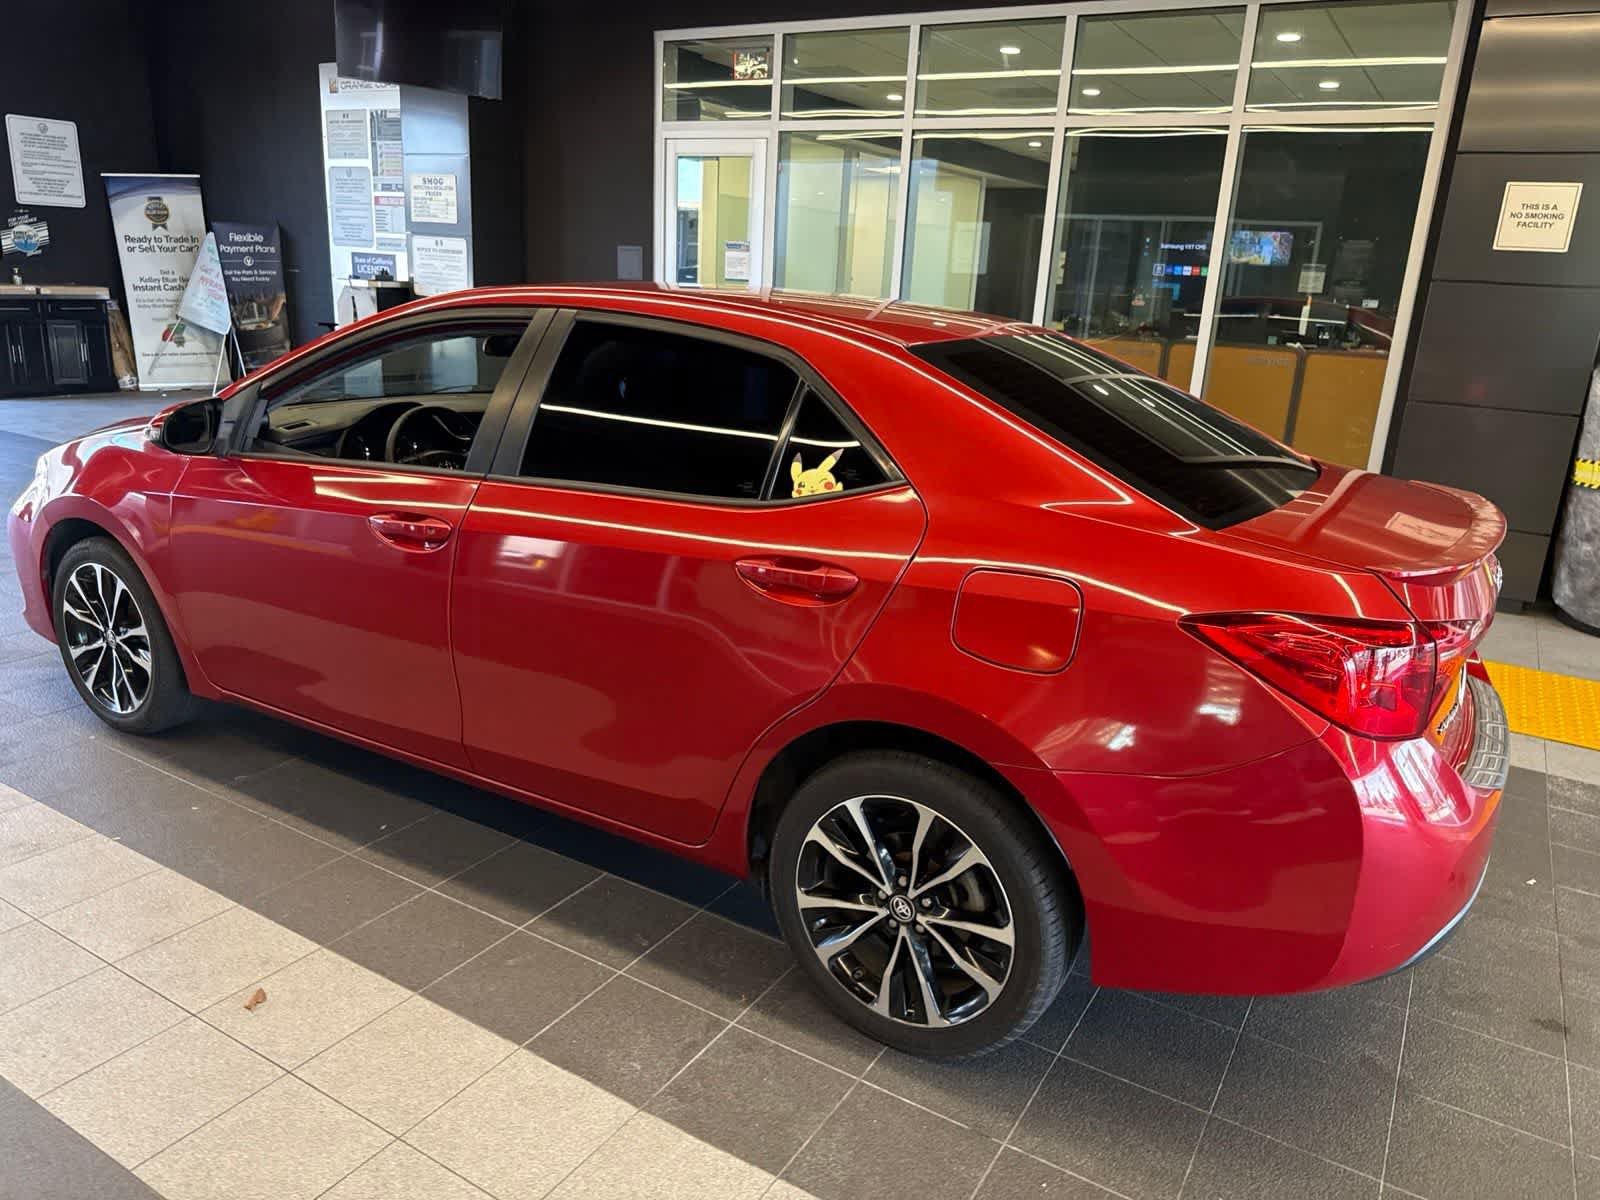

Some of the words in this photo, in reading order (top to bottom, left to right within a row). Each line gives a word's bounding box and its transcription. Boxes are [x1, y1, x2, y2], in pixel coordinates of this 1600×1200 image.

[422, 177, 444, 185] SMOG
[1524, 212, 1564, 220] SMOKING
[124, 235, 152, 245] Ready
[154, 235, 162, 243] to
[165, 235, 189, 243] Trade
[191, 235, 199, 243] In
[229, 232, 264, 242] Flexible
[138, 245, 156, 253] Sell
[159, 245, 176, 253] Your
[180, 245, 200, 253] Car?
[220, 244, 254, 254] Payment
[256, 244, 276, 253] Plans
[140, 276, 160, 284] Kelley
